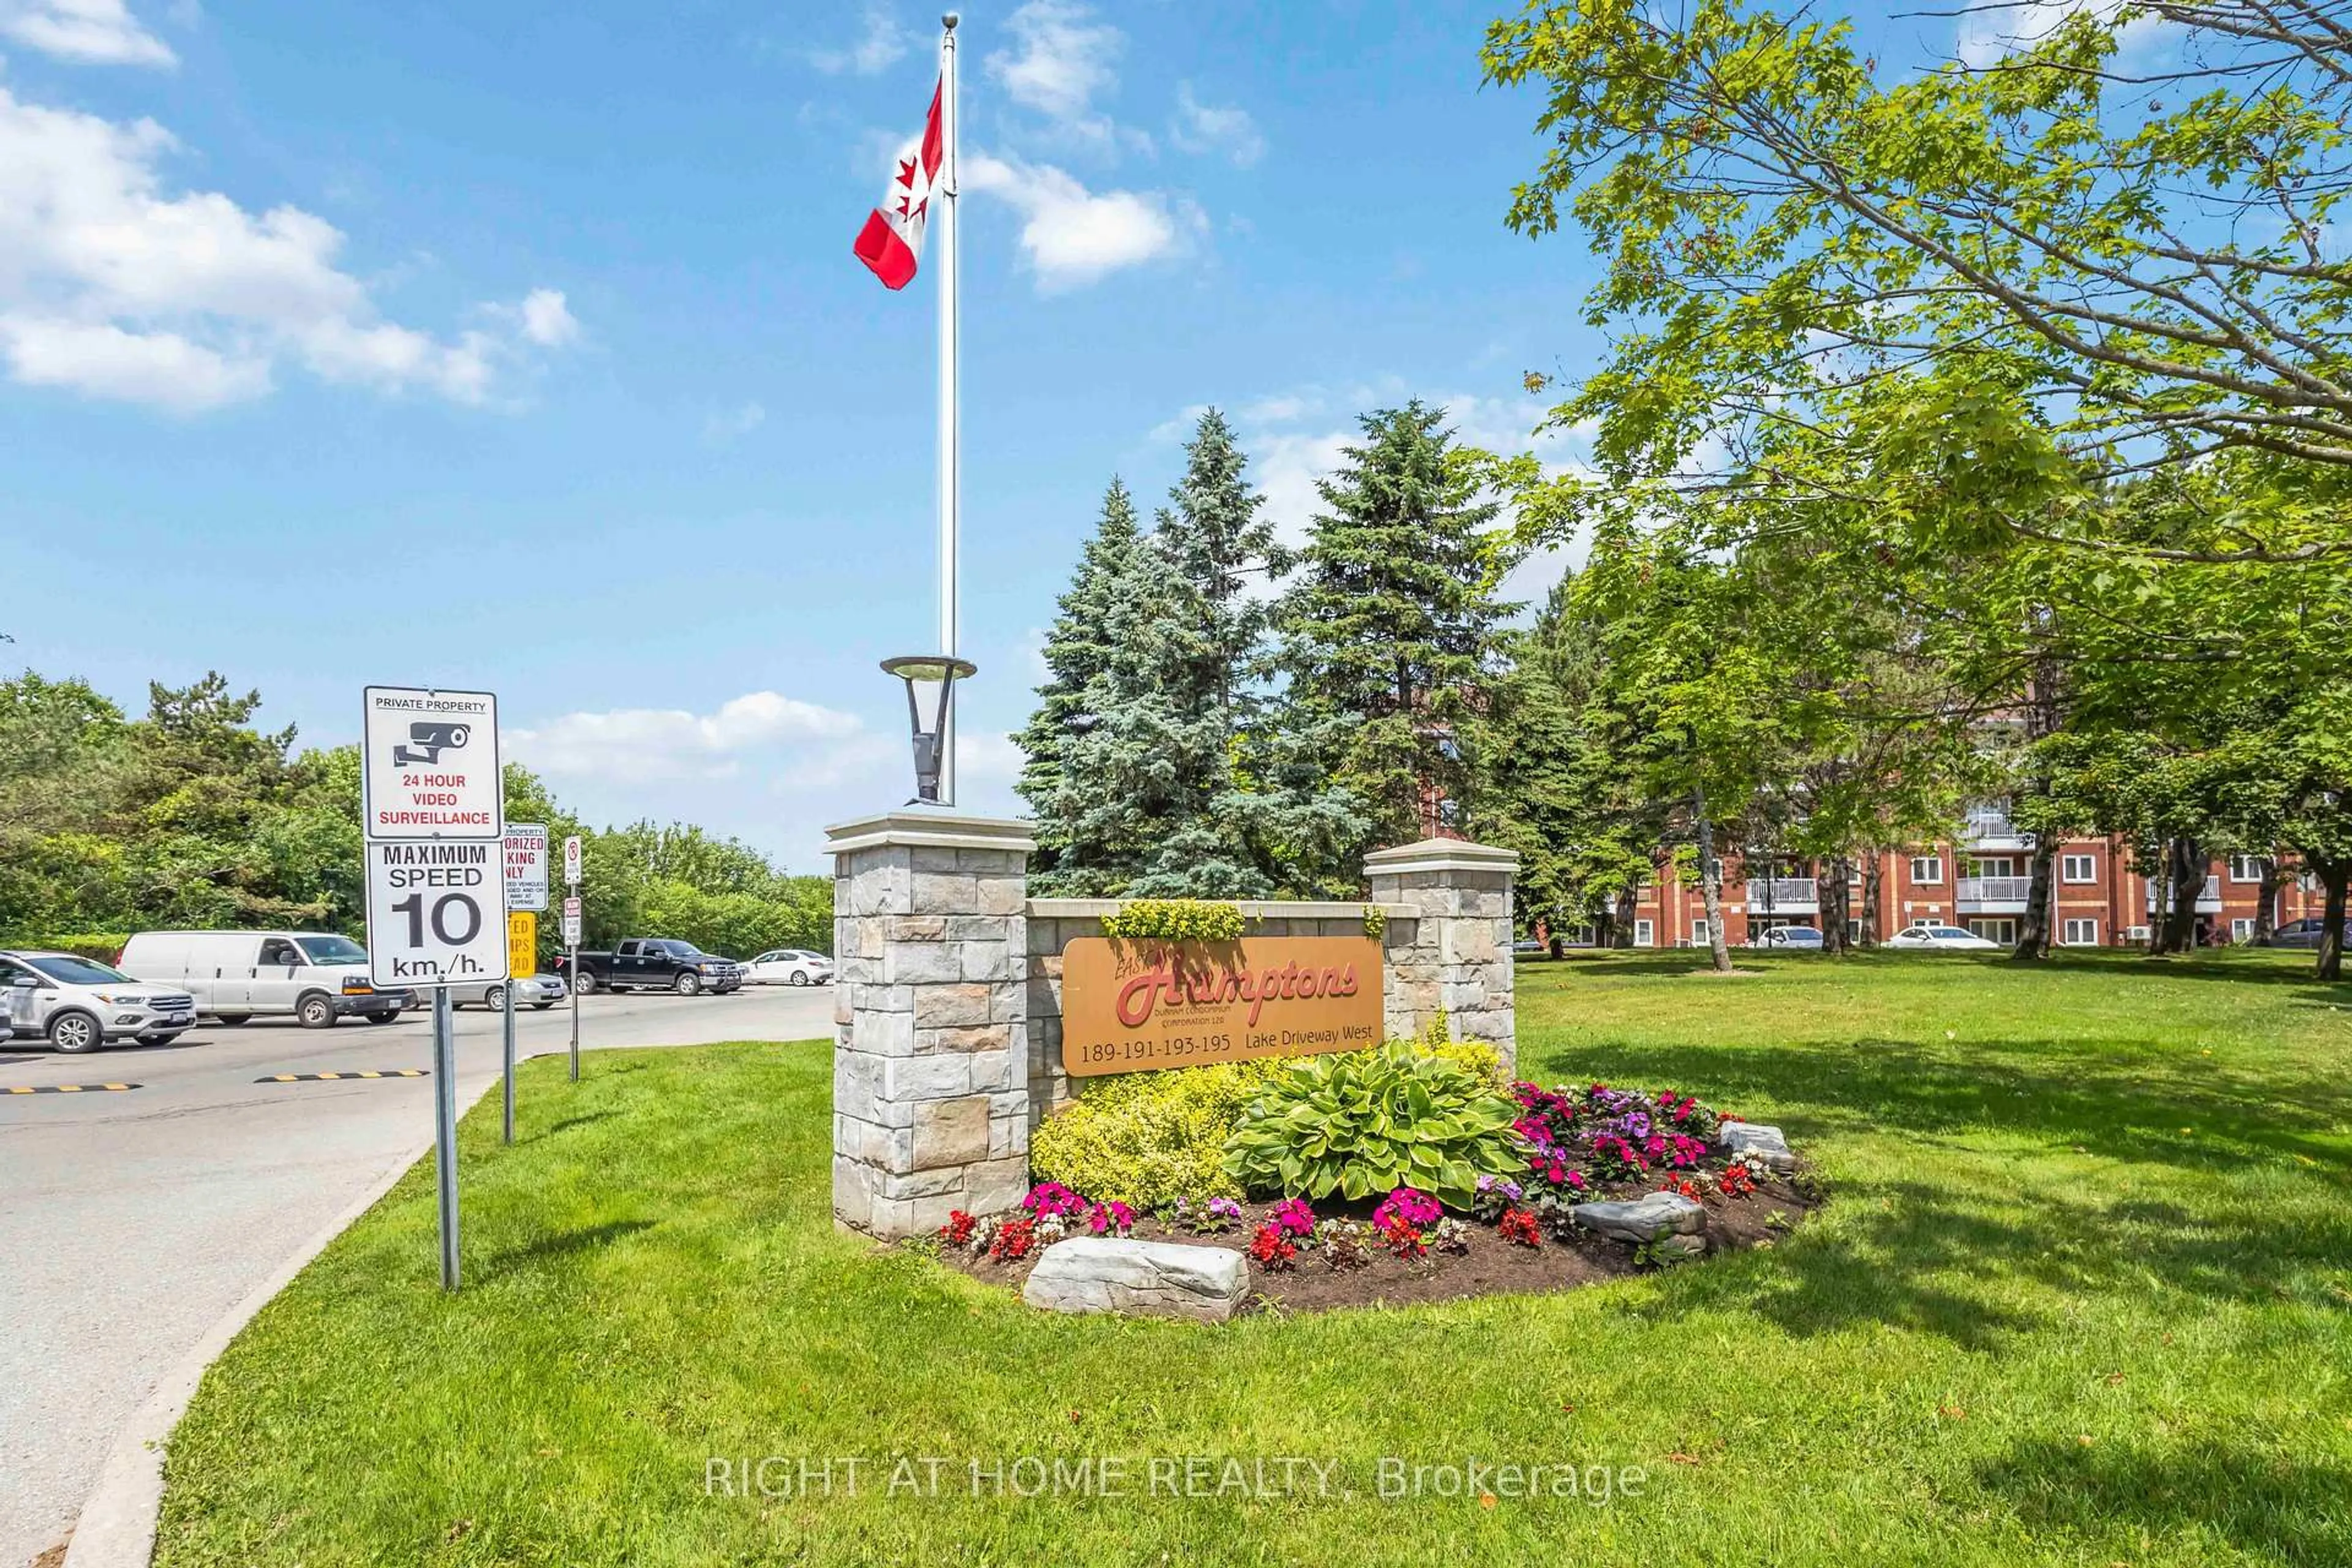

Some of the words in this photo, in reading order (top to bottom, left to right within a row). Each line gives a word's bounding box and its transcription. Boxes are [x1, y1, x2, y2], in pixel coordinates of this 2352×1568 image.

[375, 697, 423, 709] PRIVATE
[426, 700, 486, 712] PROPERTY
[402, 774, 420, 786] 24
[424, 775, 466, 788] HOUR
[412, 793, 457, 806] VIDEO
[379, 811, 490, 824] SURVEILLANCE
[383, 845, 486, 865] MAXIMUM
[389, 868, 483, 888] SPEED
[391, 892, 481, 948] 10
[1082, 1035, 1231, 1063] 189-191-193-195
[1246, 1033, 1276, 1049] Lake
[1282, 1027, 1340, 1048] Driveway
[1343, 1025, 1373, 1041] West
